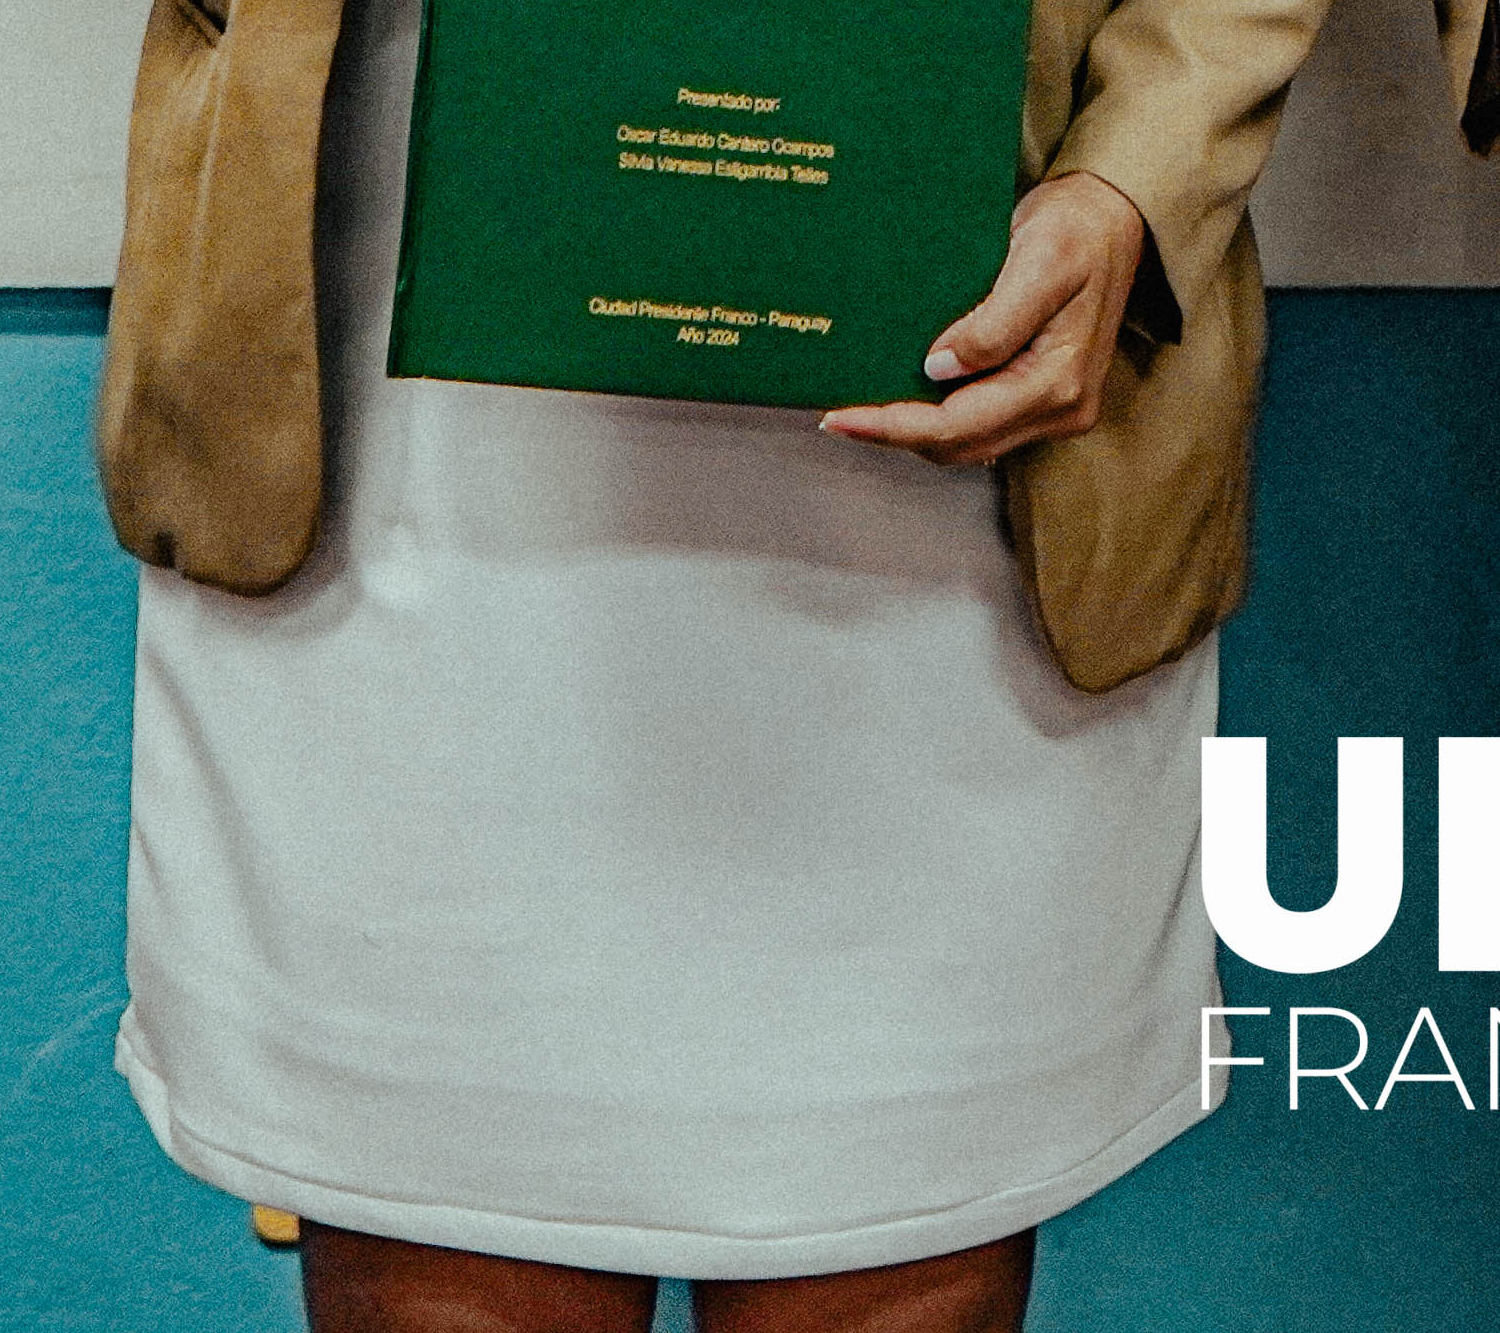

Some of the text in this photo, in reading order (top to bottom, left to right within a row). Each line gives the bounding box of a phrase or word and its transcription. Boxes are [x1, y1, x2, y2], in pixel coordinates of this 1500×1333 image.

[677, 88, 753, 110] Presentado
[659, 128, 716, 148] Eduardo
[771, 138, 835, 159] Ocampos
[589, 297, 638, 316] Ciudad
[638, 301, 710, 321] Presidente
[710, 306, 758, 325] Franco
[768, 311, 832, 333] Paraguay
[677, 326, 740, 346] Año 2024
